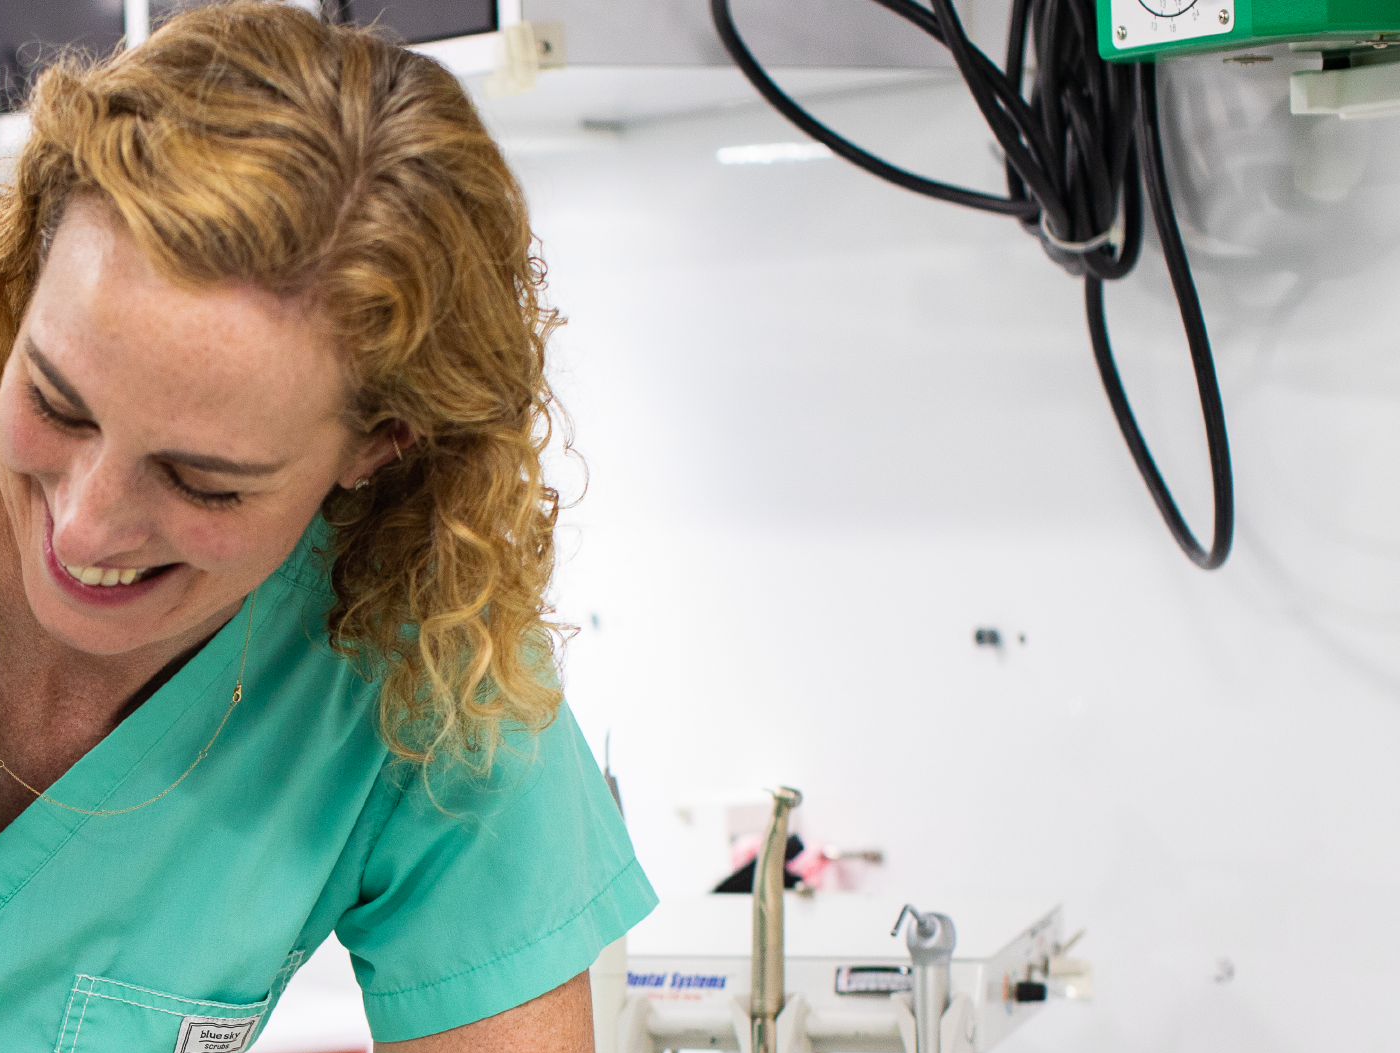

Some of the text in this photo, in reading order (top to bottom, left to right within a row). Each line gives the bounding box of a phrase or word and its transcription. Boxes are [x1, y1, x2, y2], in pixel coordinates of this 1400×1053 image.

[671, 972, 726, 990] Systems
[200, 1030, 242, 1041] blue sky
